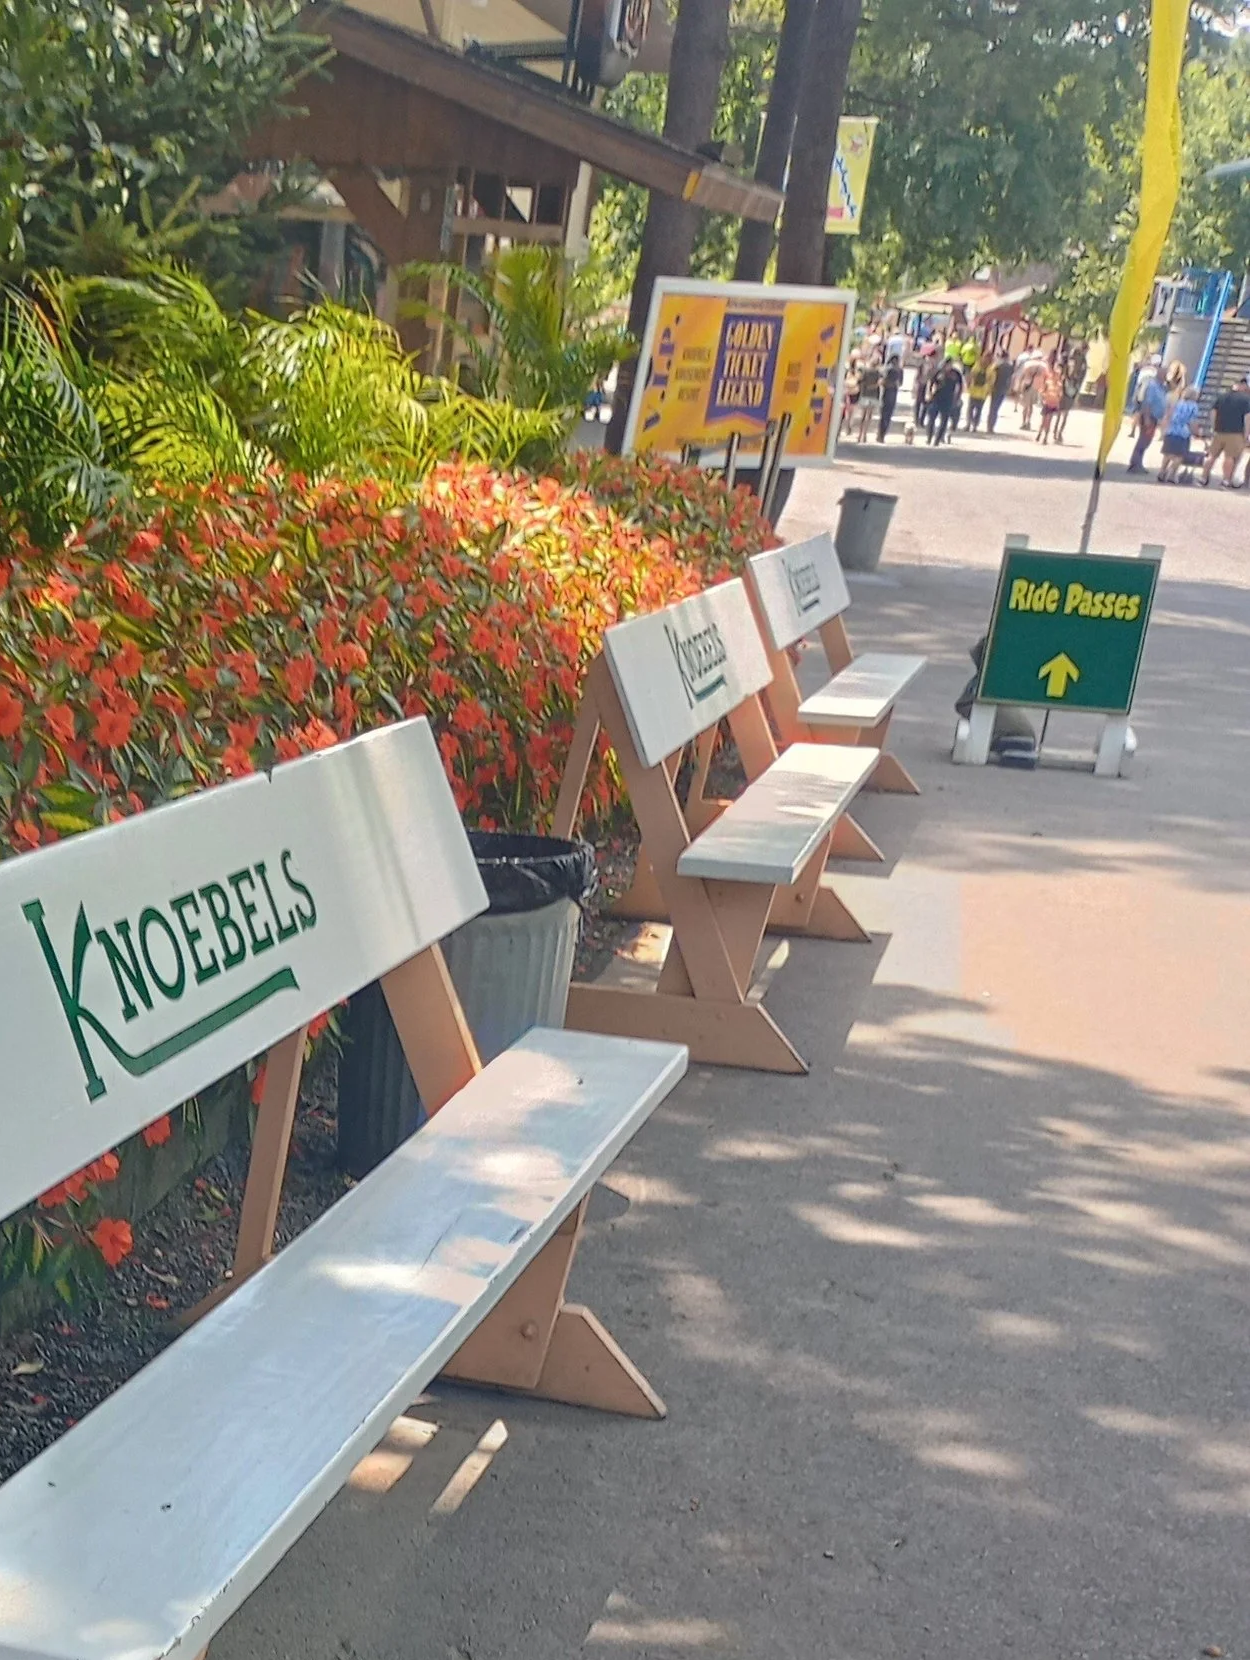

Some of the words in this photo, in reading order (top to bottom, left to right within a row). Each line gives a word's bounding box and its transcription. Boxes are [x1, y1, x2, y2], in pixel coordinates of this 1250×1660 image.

[726, 321, 774, 349] GOLDEN
[723, 350, 769, 378] TICKET
[715, 379, 764, 407] LEGEND
[1008, 577, 1061, 614] Ride
[1063, 582, 1142, 621] Passes
[21, 849, 317, 1104] KNOEBELS
